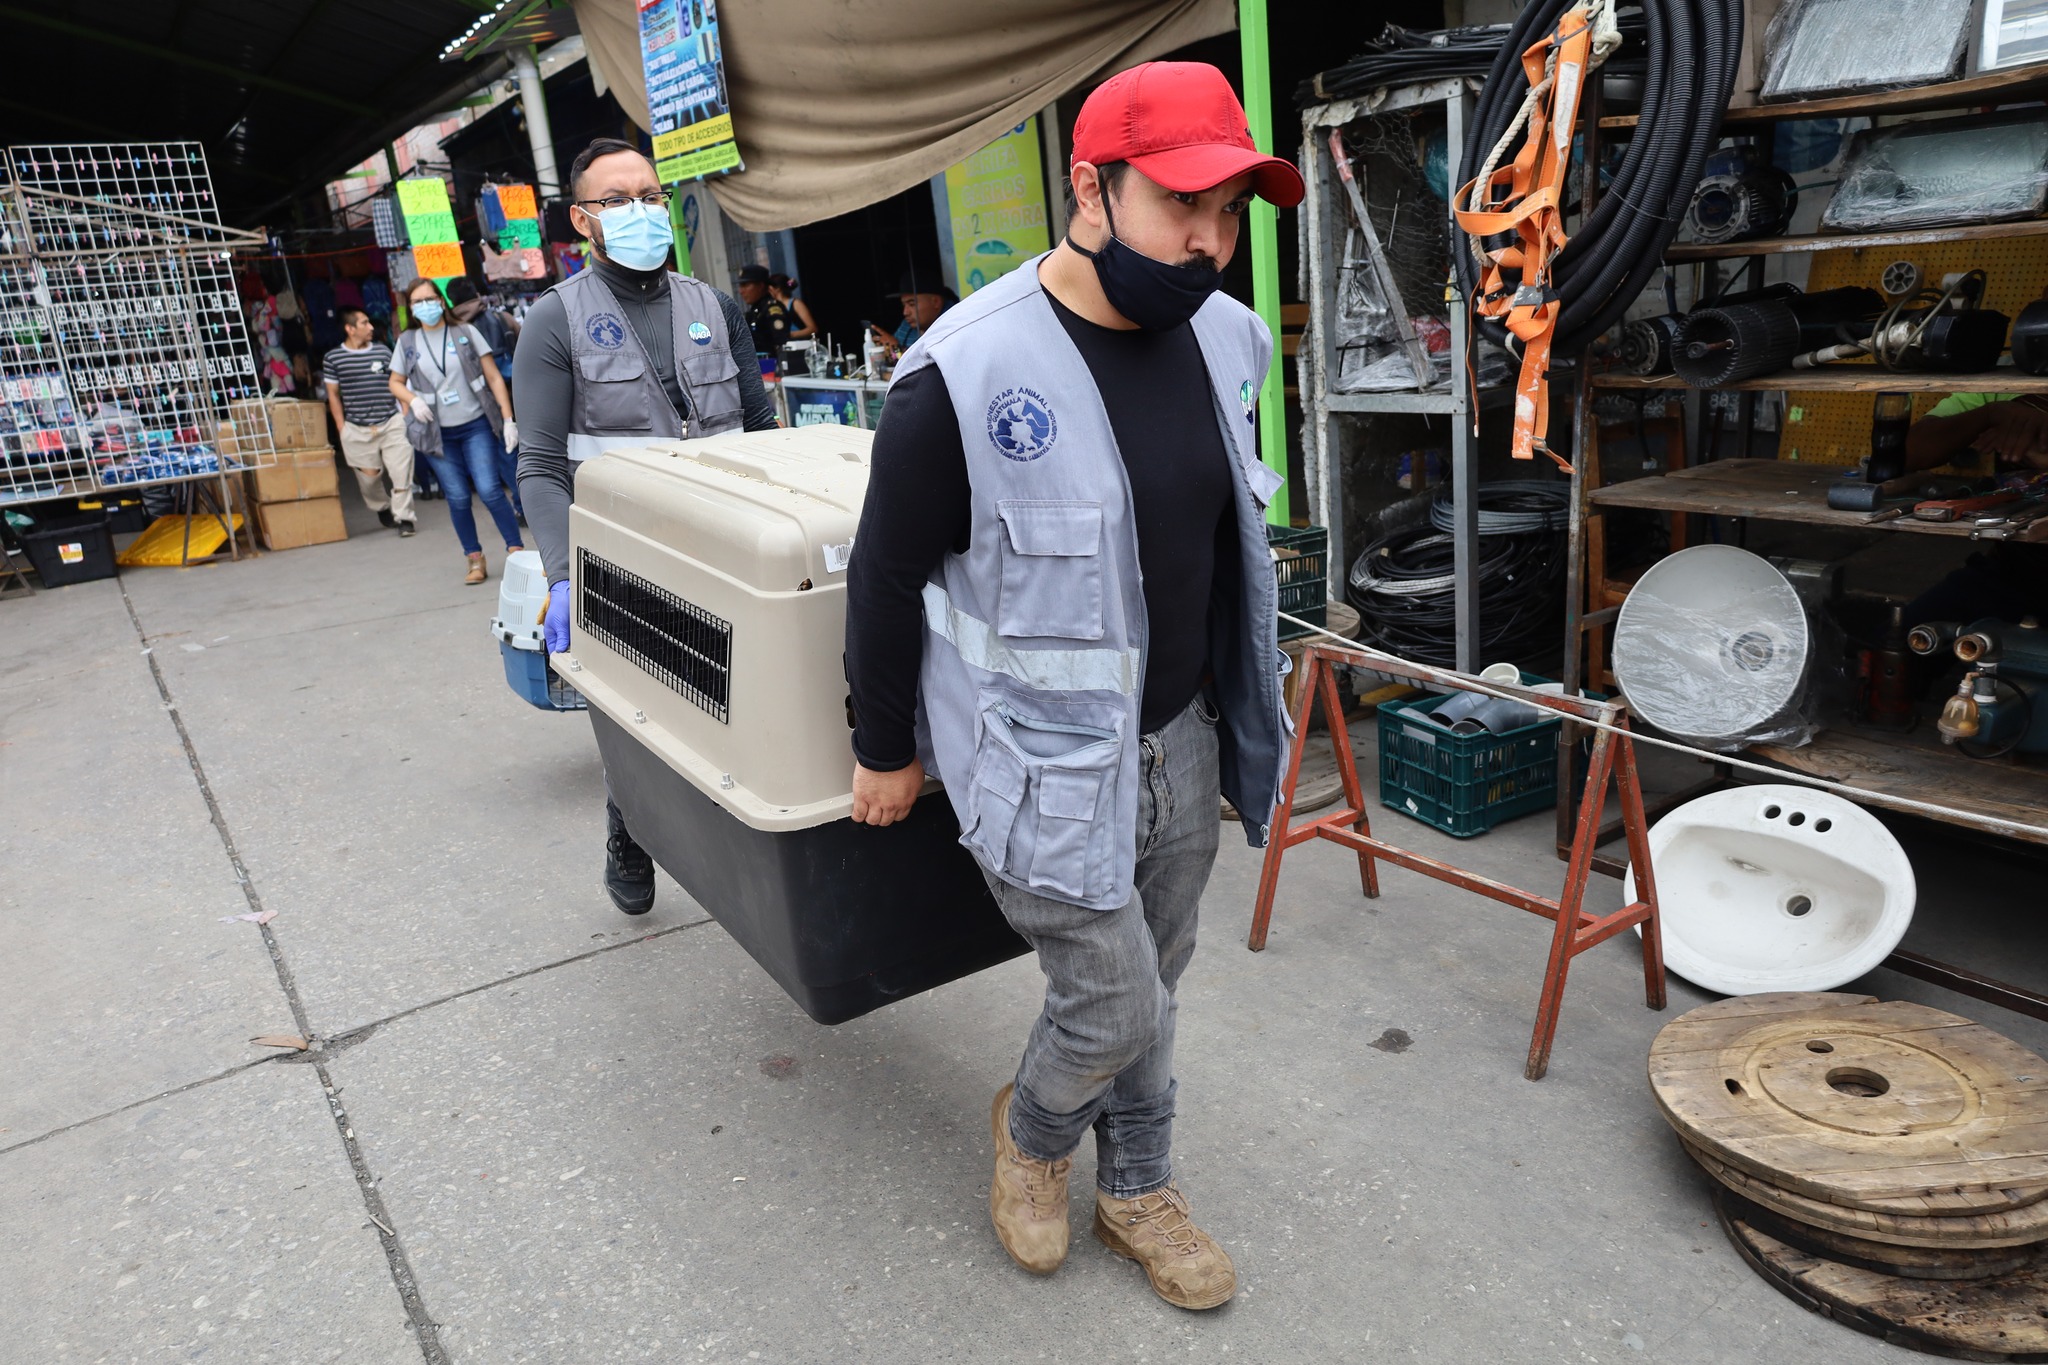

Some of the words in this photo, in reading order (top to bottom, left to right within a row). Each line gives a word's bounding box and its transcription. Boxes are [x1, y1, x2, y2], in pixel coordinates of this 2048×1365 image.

[657, 139, 673, 152] TODO
[673, 135, 687, 148] TIPO
[687, 131, 696, 144] DE
[695, 120, 732, 141] ACCESORIOS
[961, 173, 1027, 209] CARROS
[518, 203, 529, 216] 6
[998, 202, 1048, 233] HORA
[689, 330, 712, 341] MAGA
[986, 388, 1014, 430] BIENESTAR
[1017, 386, 1048, 410] ANIMAL
[992, 396, 1022, 423] GUATEMALA
